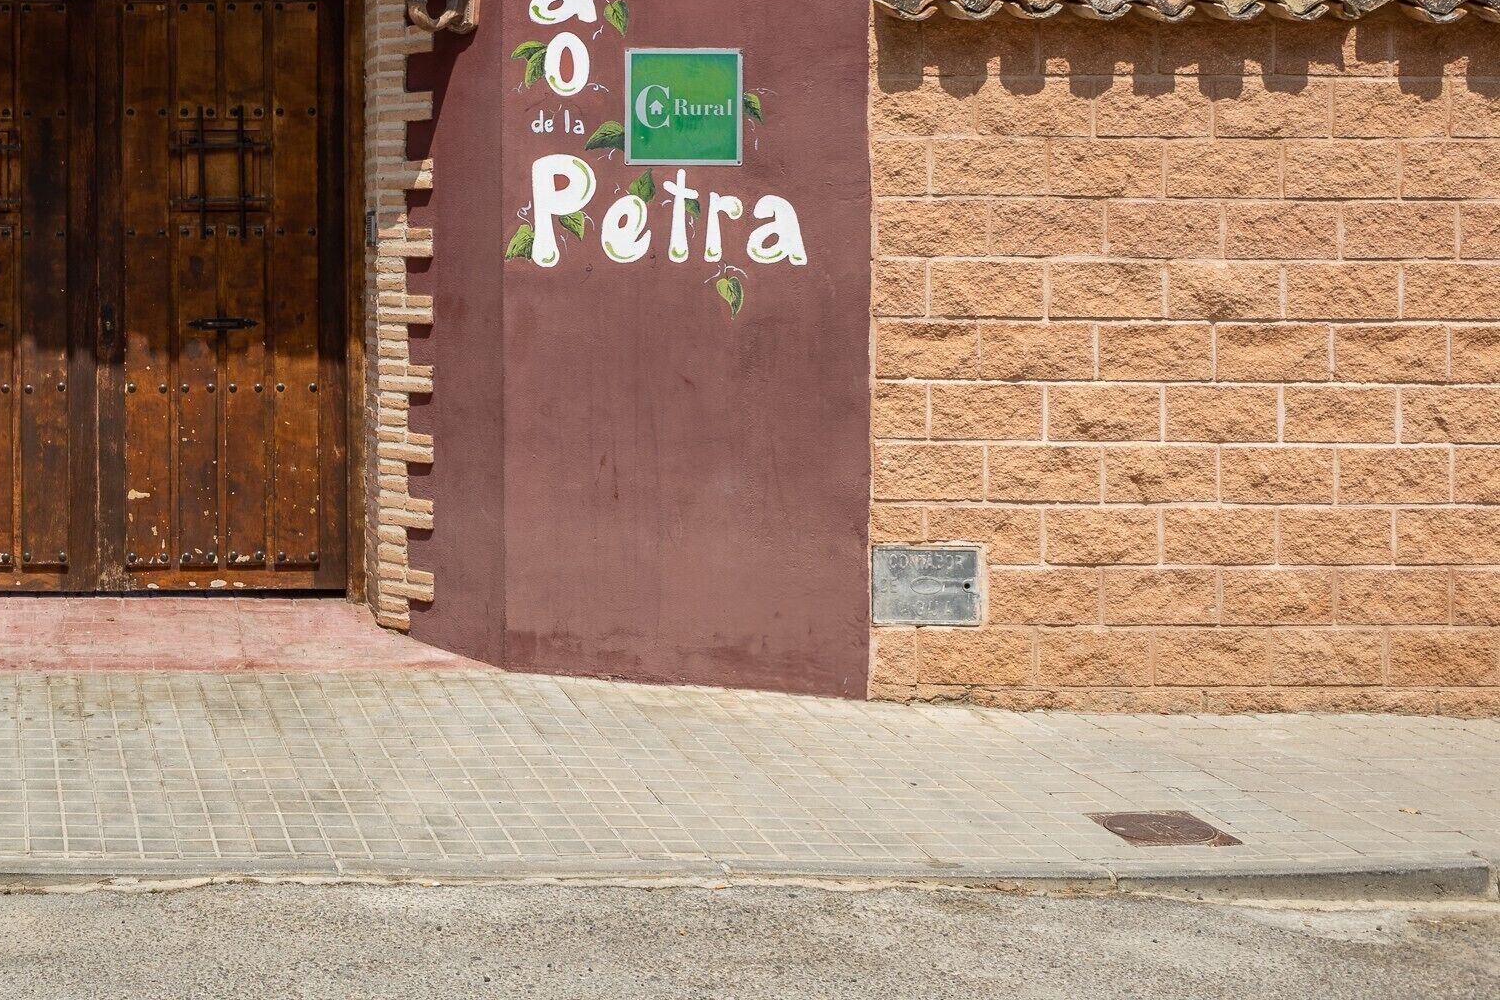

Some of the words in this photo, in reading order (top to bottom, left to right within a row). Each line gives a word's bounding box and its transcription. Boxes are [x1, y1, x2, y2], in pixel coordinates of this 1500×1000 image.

[673, 96, 733, 118] Rural
[531, 108, 554, 135] de
[564, 108, 585, 136] la
[531, 153, 808, 268] Petra
